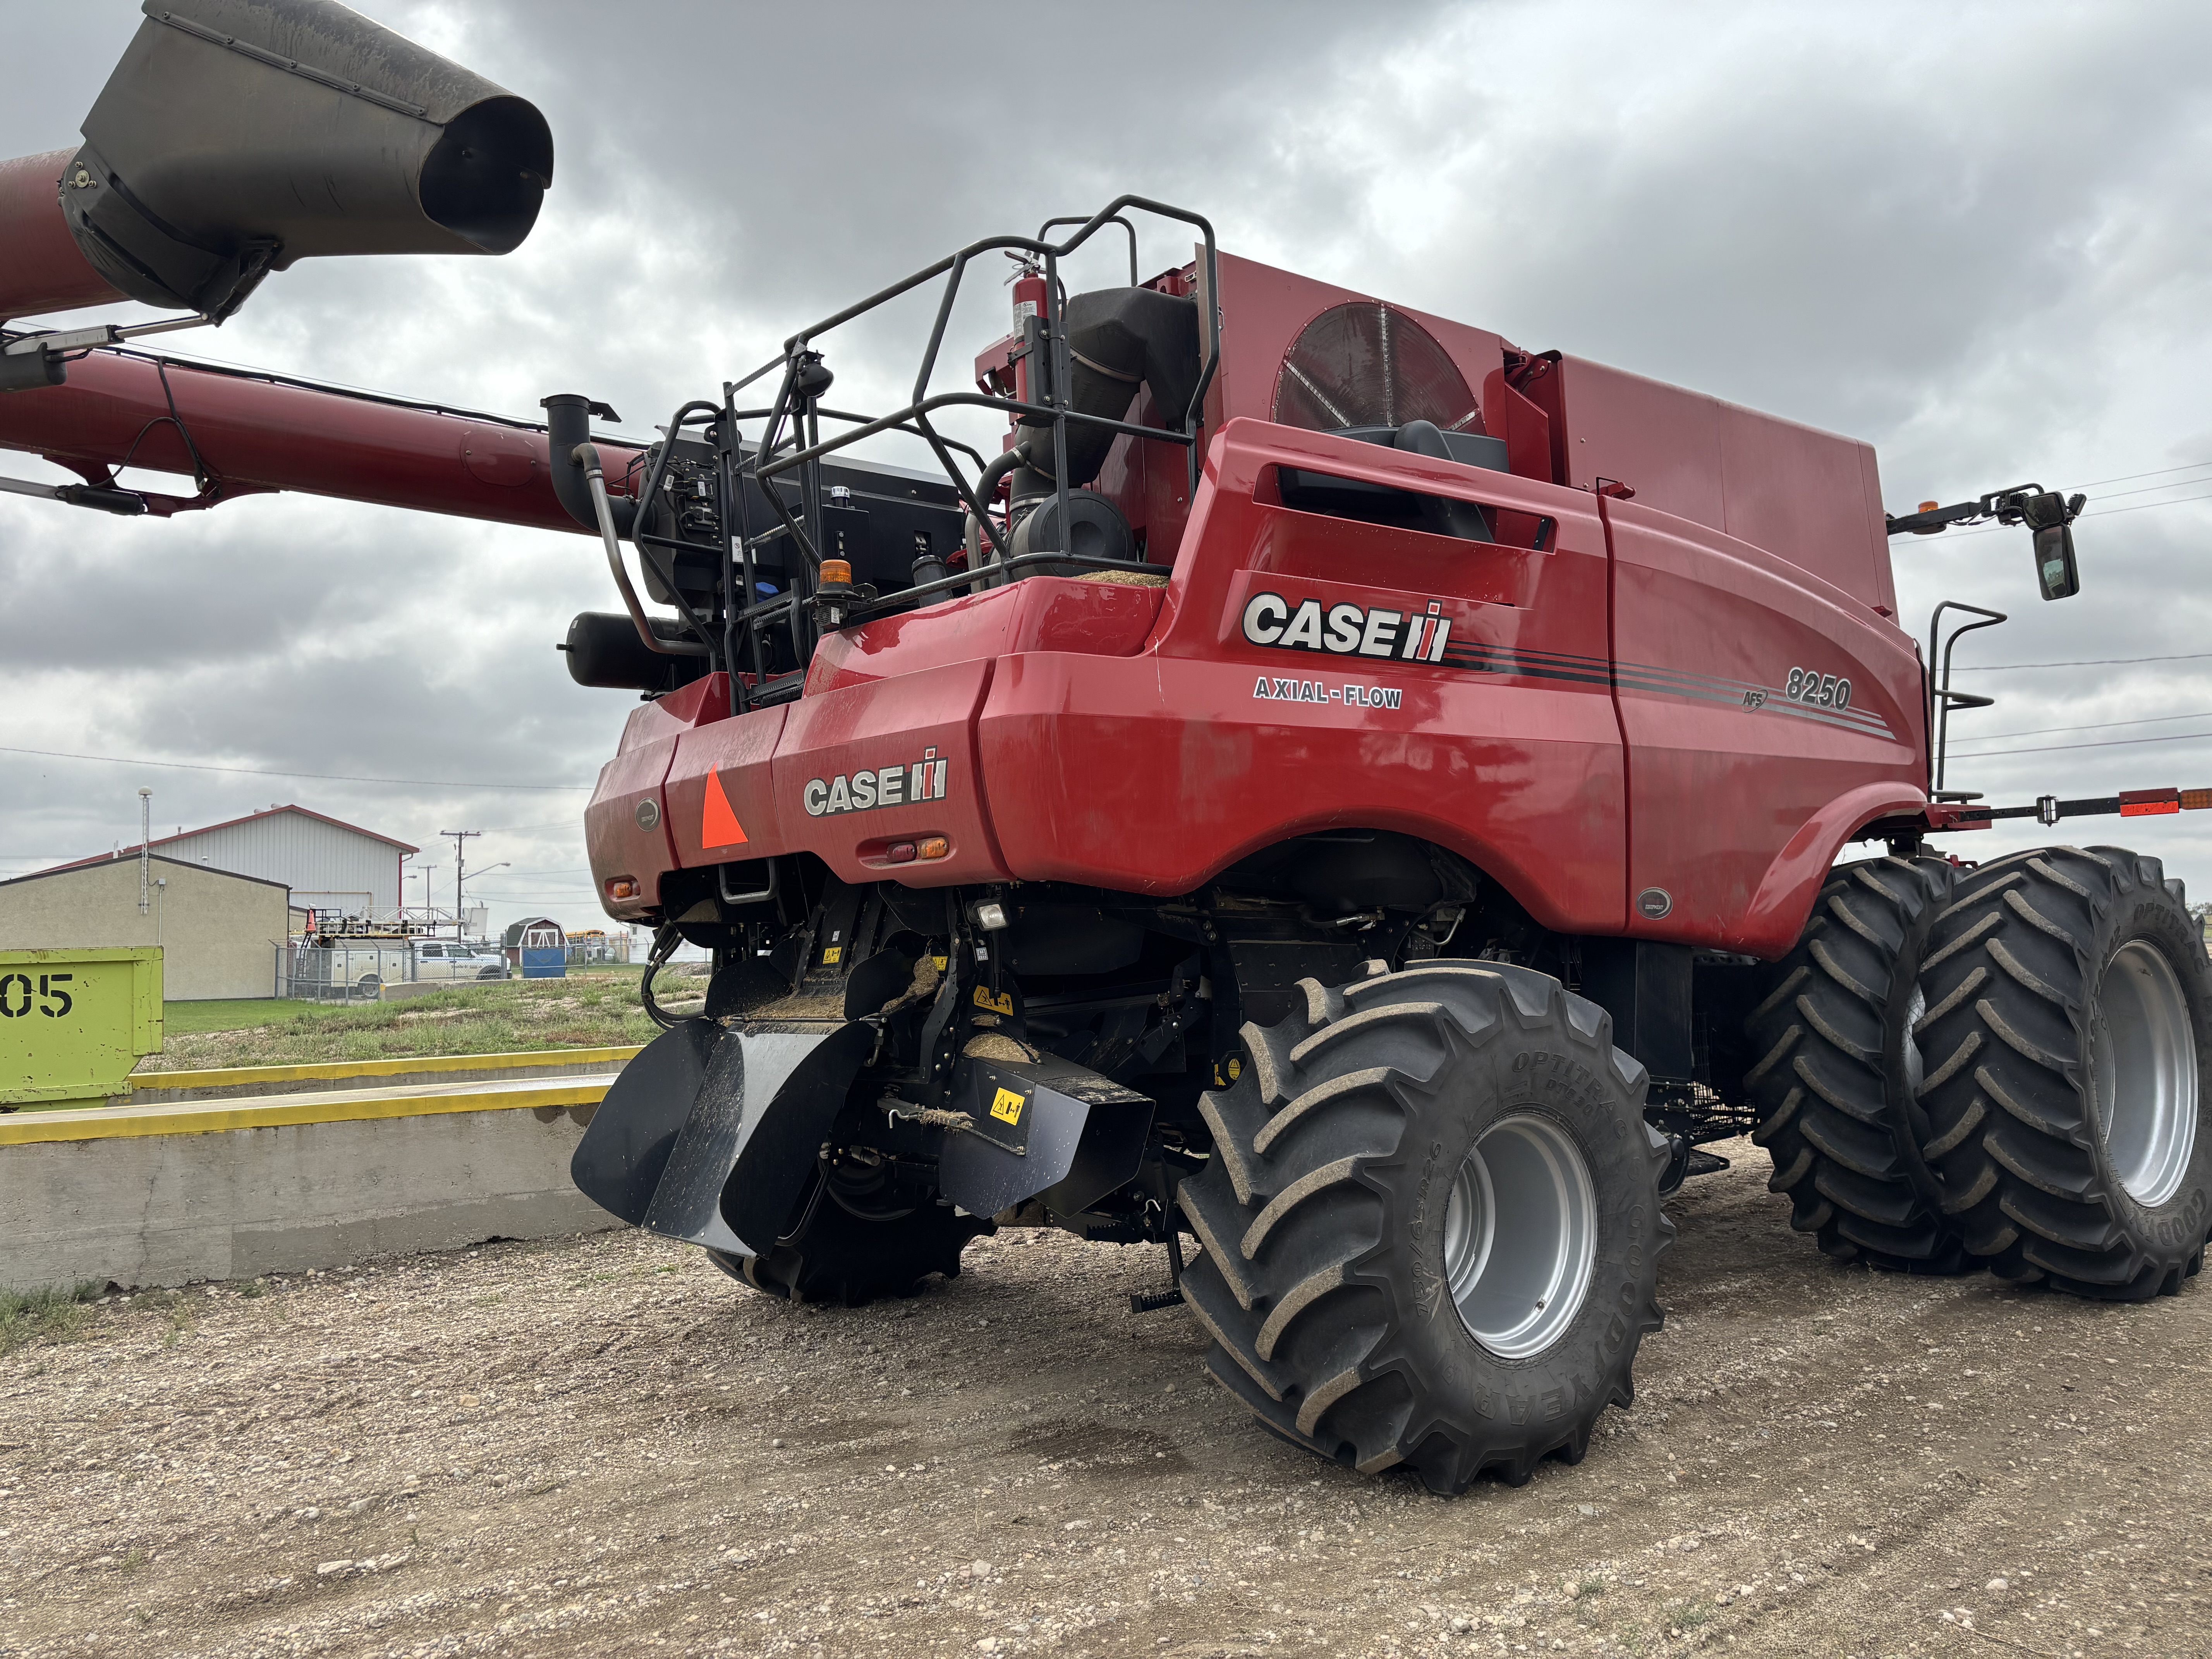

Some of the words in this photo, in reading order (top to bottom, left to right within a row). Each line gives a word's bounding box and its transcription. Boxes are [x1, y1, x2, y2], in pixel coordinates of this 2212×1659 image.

[1243, 594, 1401, 656] CASE
[1252, 676, 1402, 710] AXIAL-FLOW
[1743, 691, 1763, 707] AFS
[1785, 666, 1851, 712] 8250
[804, 766, 904, 816] CASE
[2133, 902, 2205, 975] OPTITRAC
[1511, 1050, 1628, 1140] OPTITRAC
[1473, 1204, 1646, 1426] GOODYEAR
